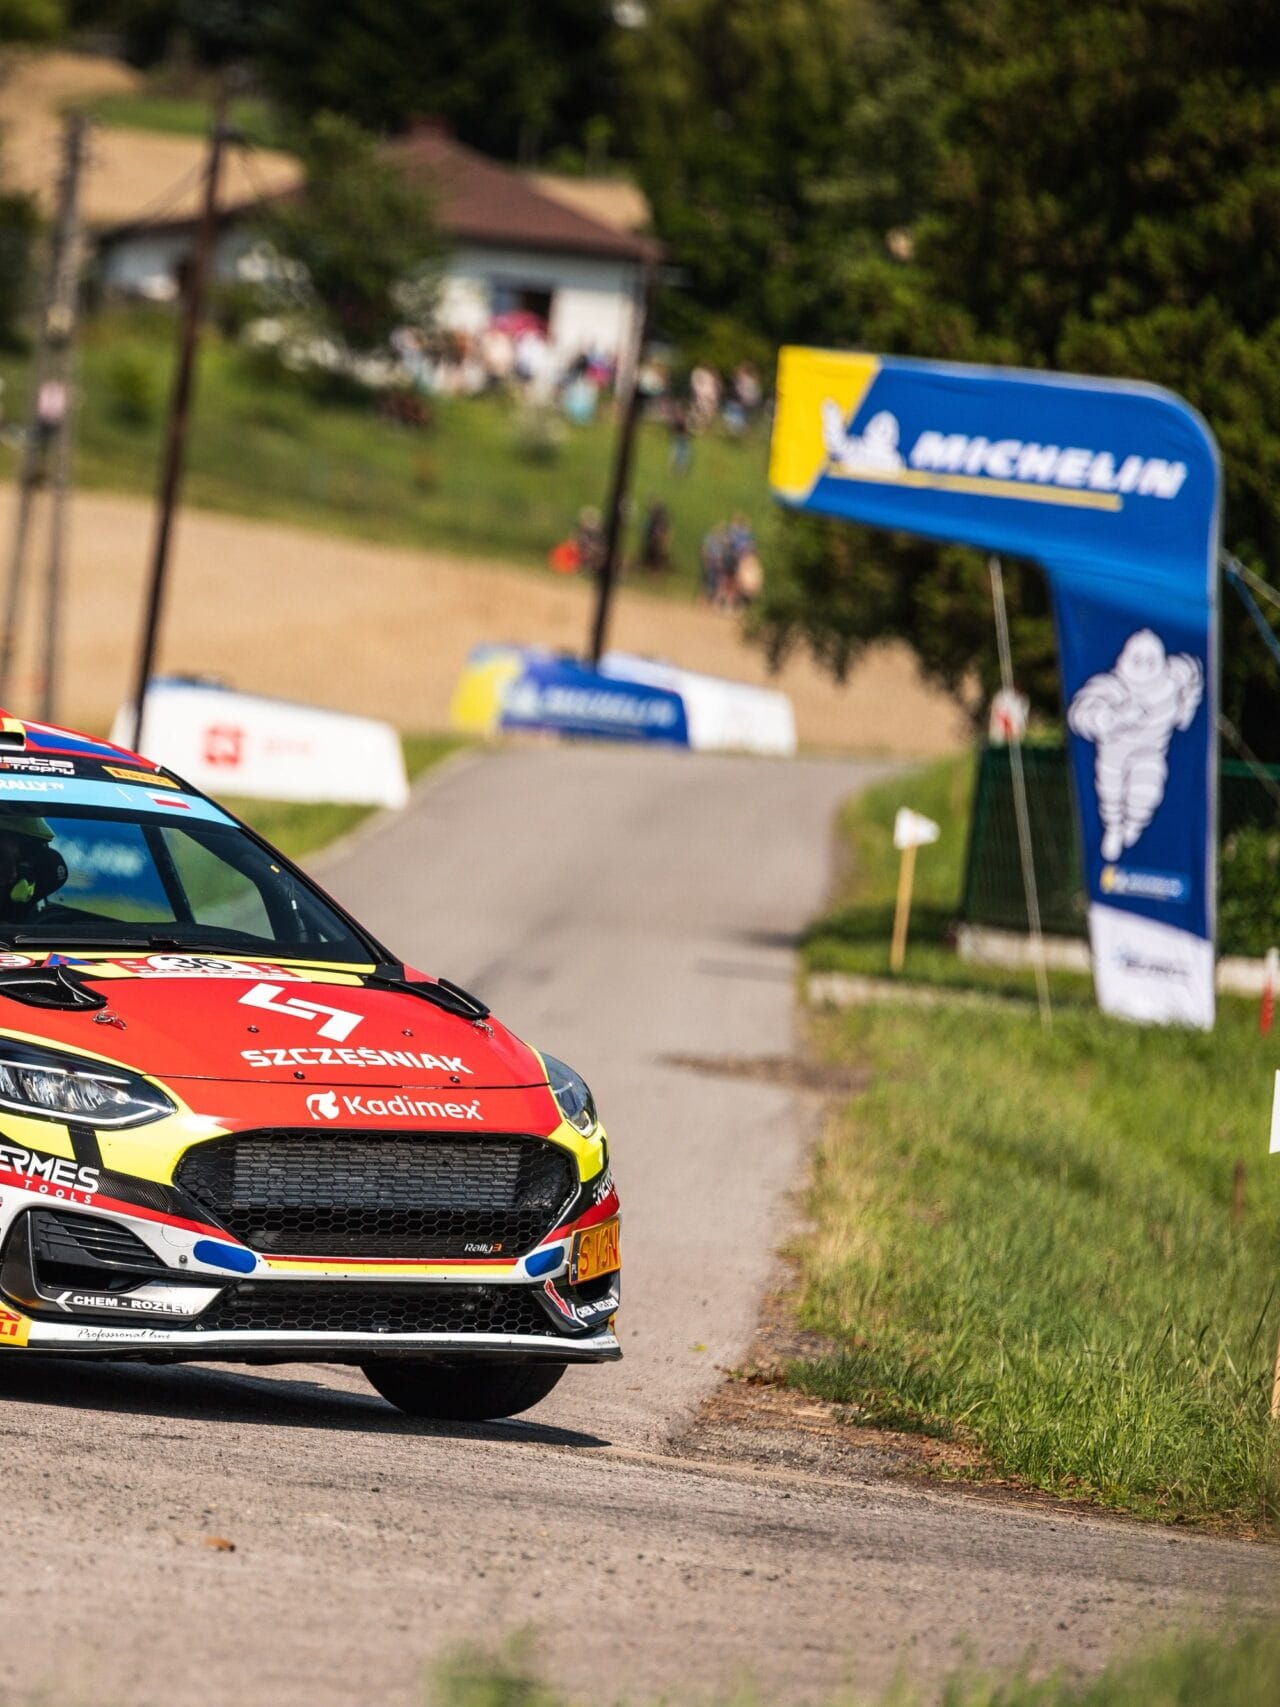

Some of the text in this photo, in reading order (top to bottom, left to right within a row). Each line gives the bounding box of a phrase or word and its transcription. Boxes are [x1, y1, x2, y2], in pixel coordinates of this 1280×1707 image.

[909, 431, 1188, 500] MICHELIN
[160, 956, 232, 970] 36
[240, 1047, 474, 1074] SZCZĘŚNIAK
[342, 1094, 484, 1121] Kadimex
[24, 1179, 92, 1204] TOOLS
[72, 1295, 118, 1307] CHEM
